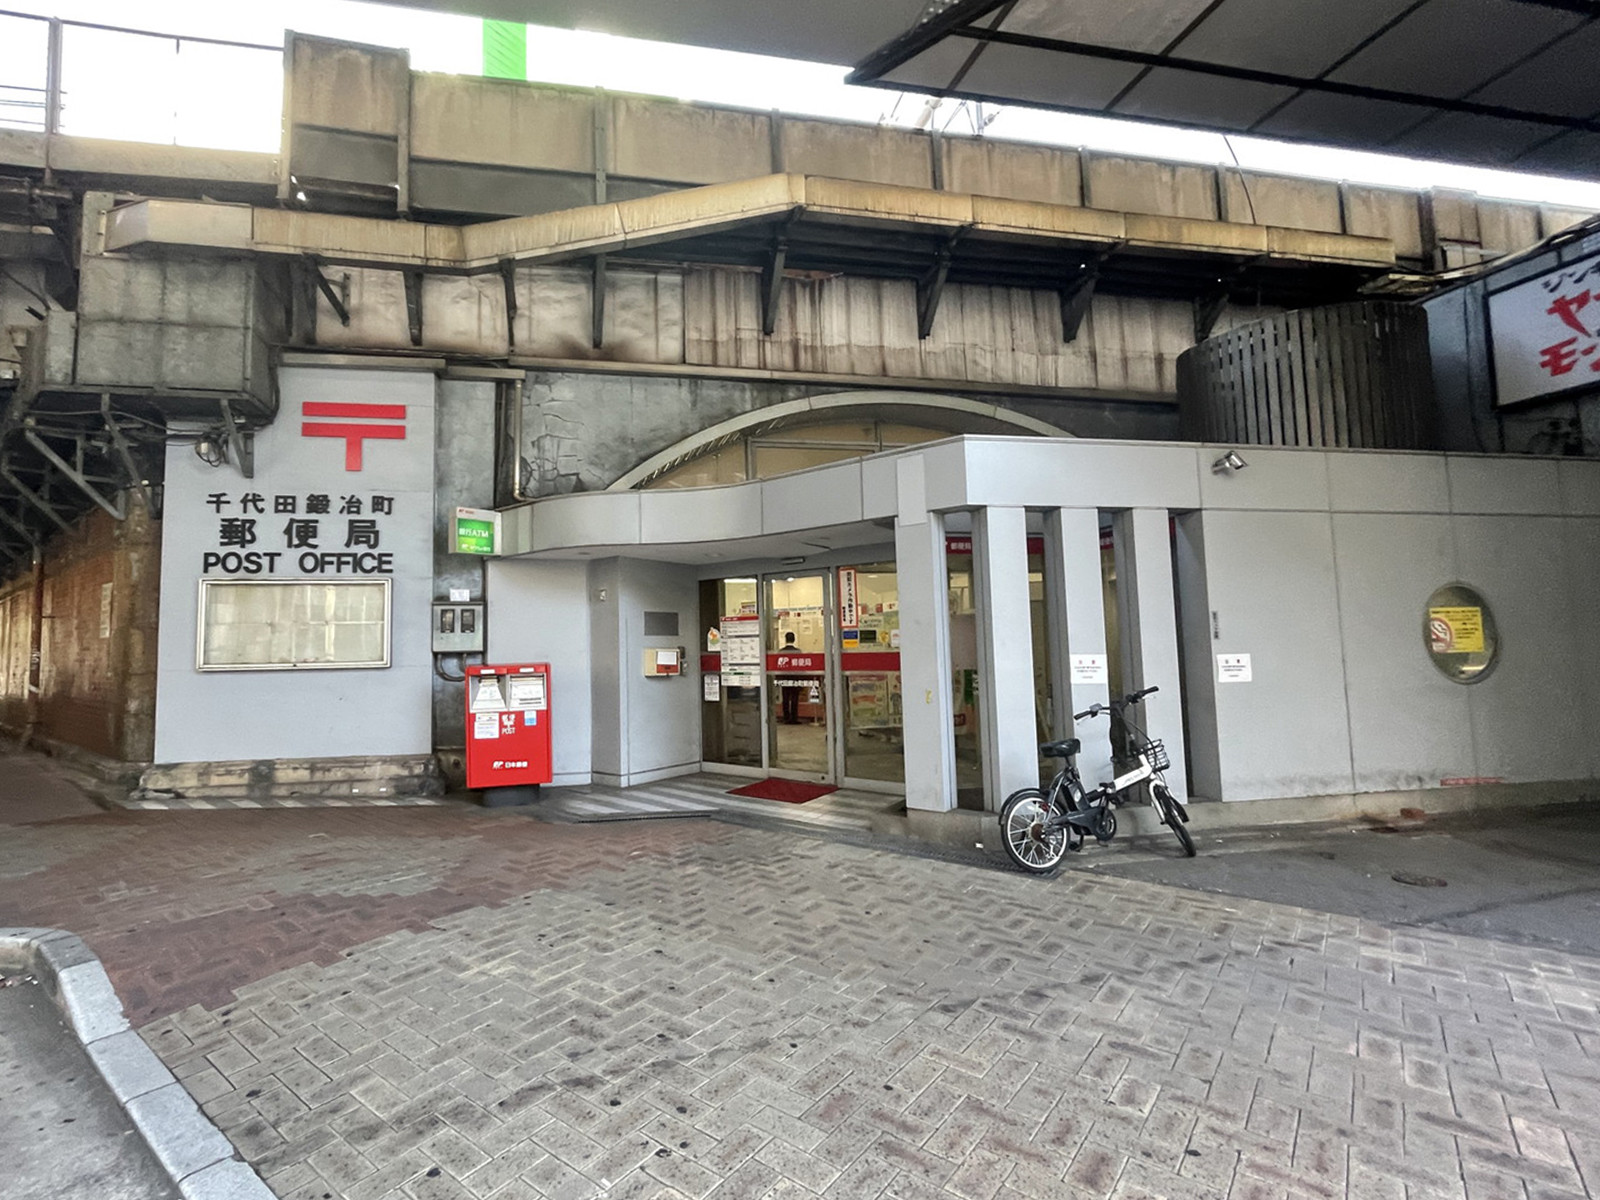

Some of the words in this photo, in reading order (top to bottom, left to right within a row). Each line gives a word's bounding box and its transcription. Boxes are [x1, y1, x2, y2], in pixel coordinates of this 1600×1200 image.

[206, 493, 395, 515] 千代田鍛冶町
[219, 518, 380, 550] 郵便局
[203, 552, 281, 574] POST
[298, 552, 394, 574] OFFICE
[501, 727, 516, 735] POST
